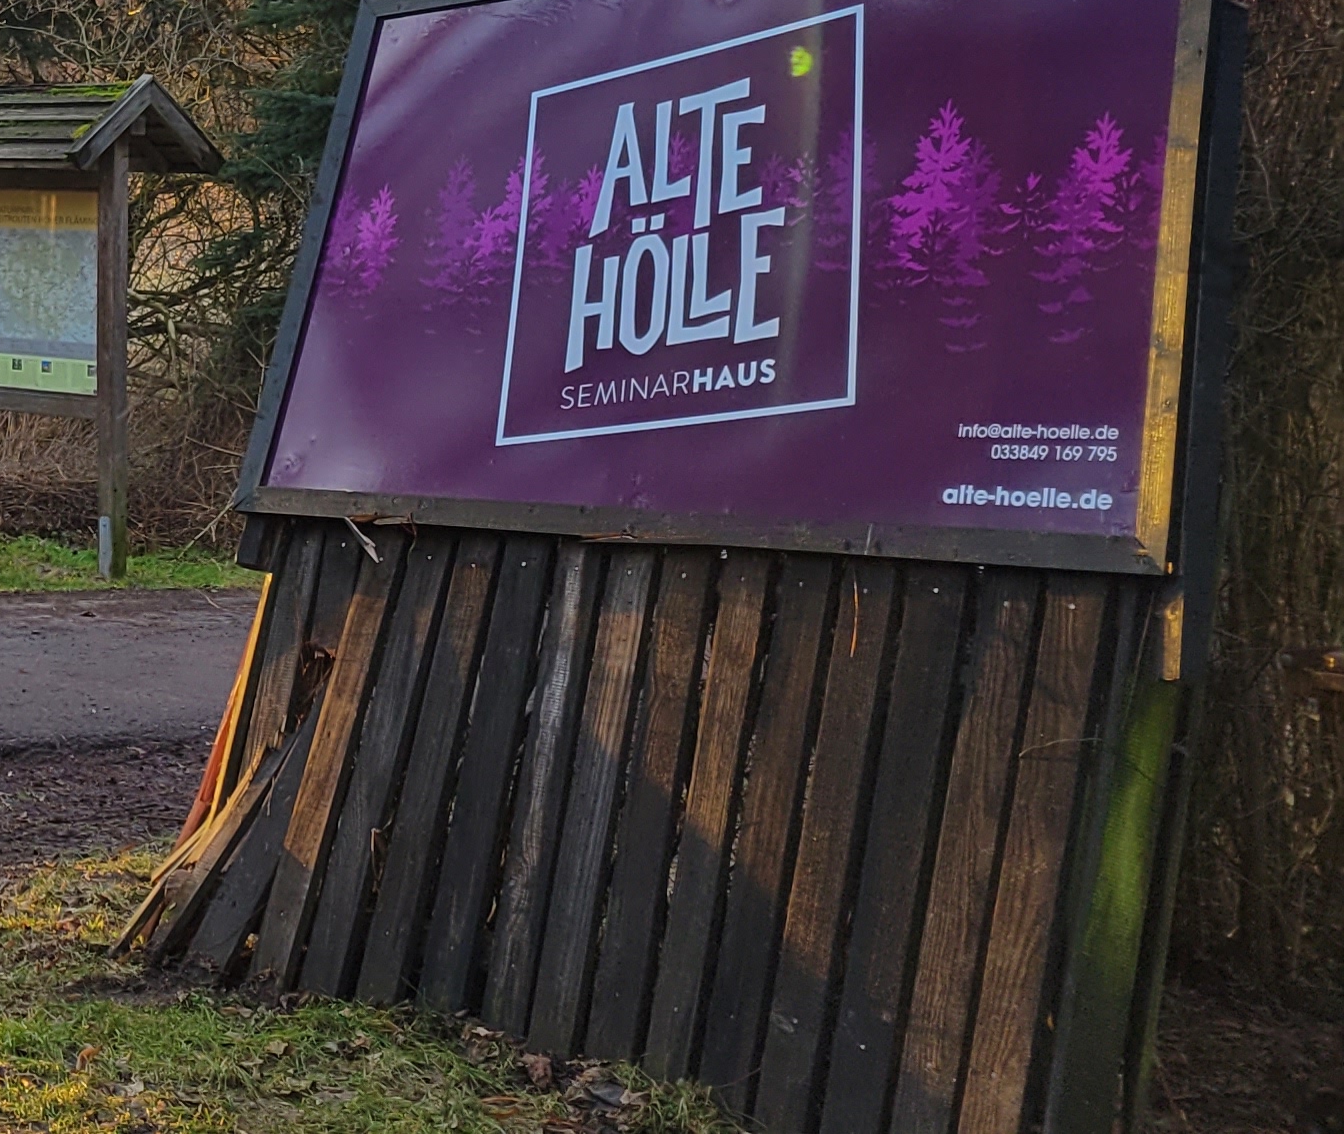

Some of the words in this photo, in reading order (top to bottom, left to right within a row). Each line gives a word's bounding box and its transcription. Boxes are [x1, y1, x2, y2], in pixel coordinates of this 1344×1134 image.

[588, 77, 766, 238] ALTE
[564, 207, 786, 373] HÖLLE
[559, 359, 777, 410] SEMINARHAUS
[958, 423, 1119, 440] info@alte-hoelle.de
[990, 444, 1049, 460] 033849
[1055, 445, 1083, 461] 169
[1087, 446, 1118, 462] 795
[942, 484, 1113, 511] alte-hoelle.de
